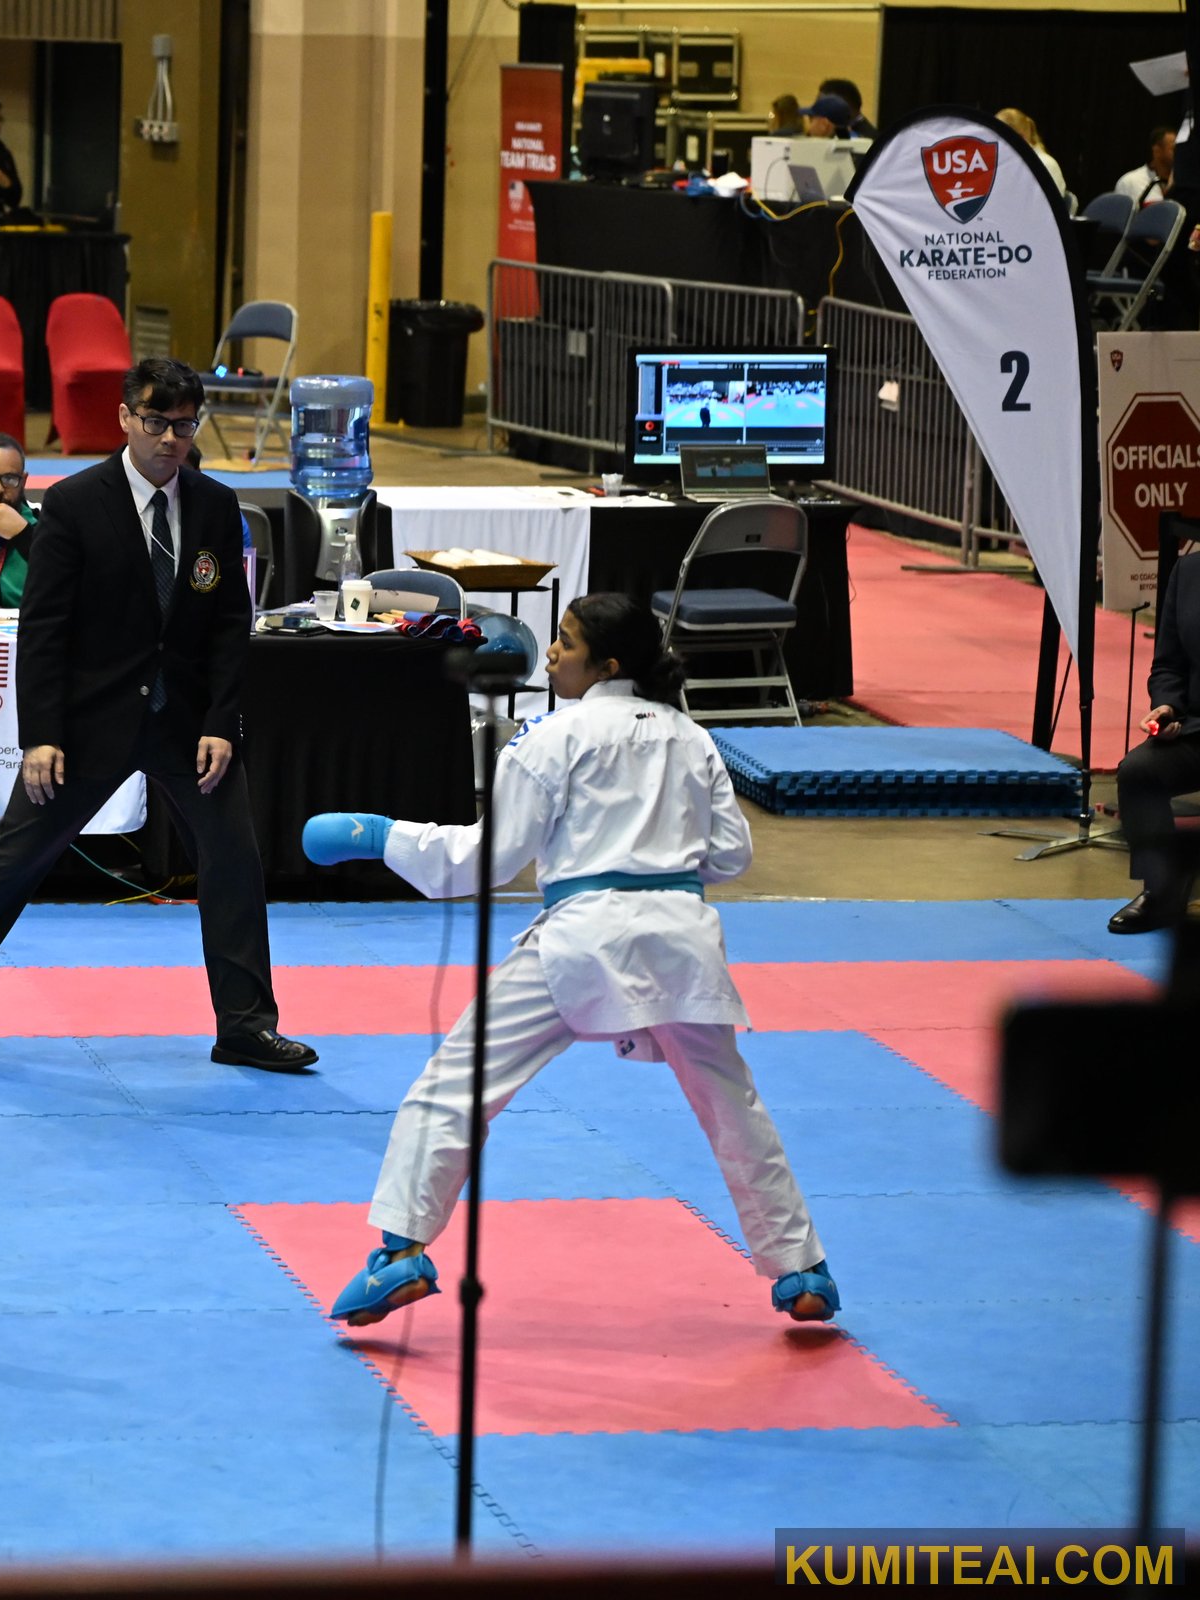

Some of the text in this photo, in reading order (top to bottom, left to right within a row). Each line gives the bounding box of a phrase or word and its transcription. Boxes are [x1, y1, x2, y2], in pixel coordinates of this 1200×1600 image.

[501, 151, 556, 172] TEAM TRIALS
[932, 149, 988, 174] USA
[925, 231, 1004, 246] NATIONAL
[900, 245, 1032, 267] KARATE-DO
[928, 268, 1006, 280] FEDERATION
[1000, 350, 1031, 412] 2
[1135, 482, 1188, 508] ONLY
